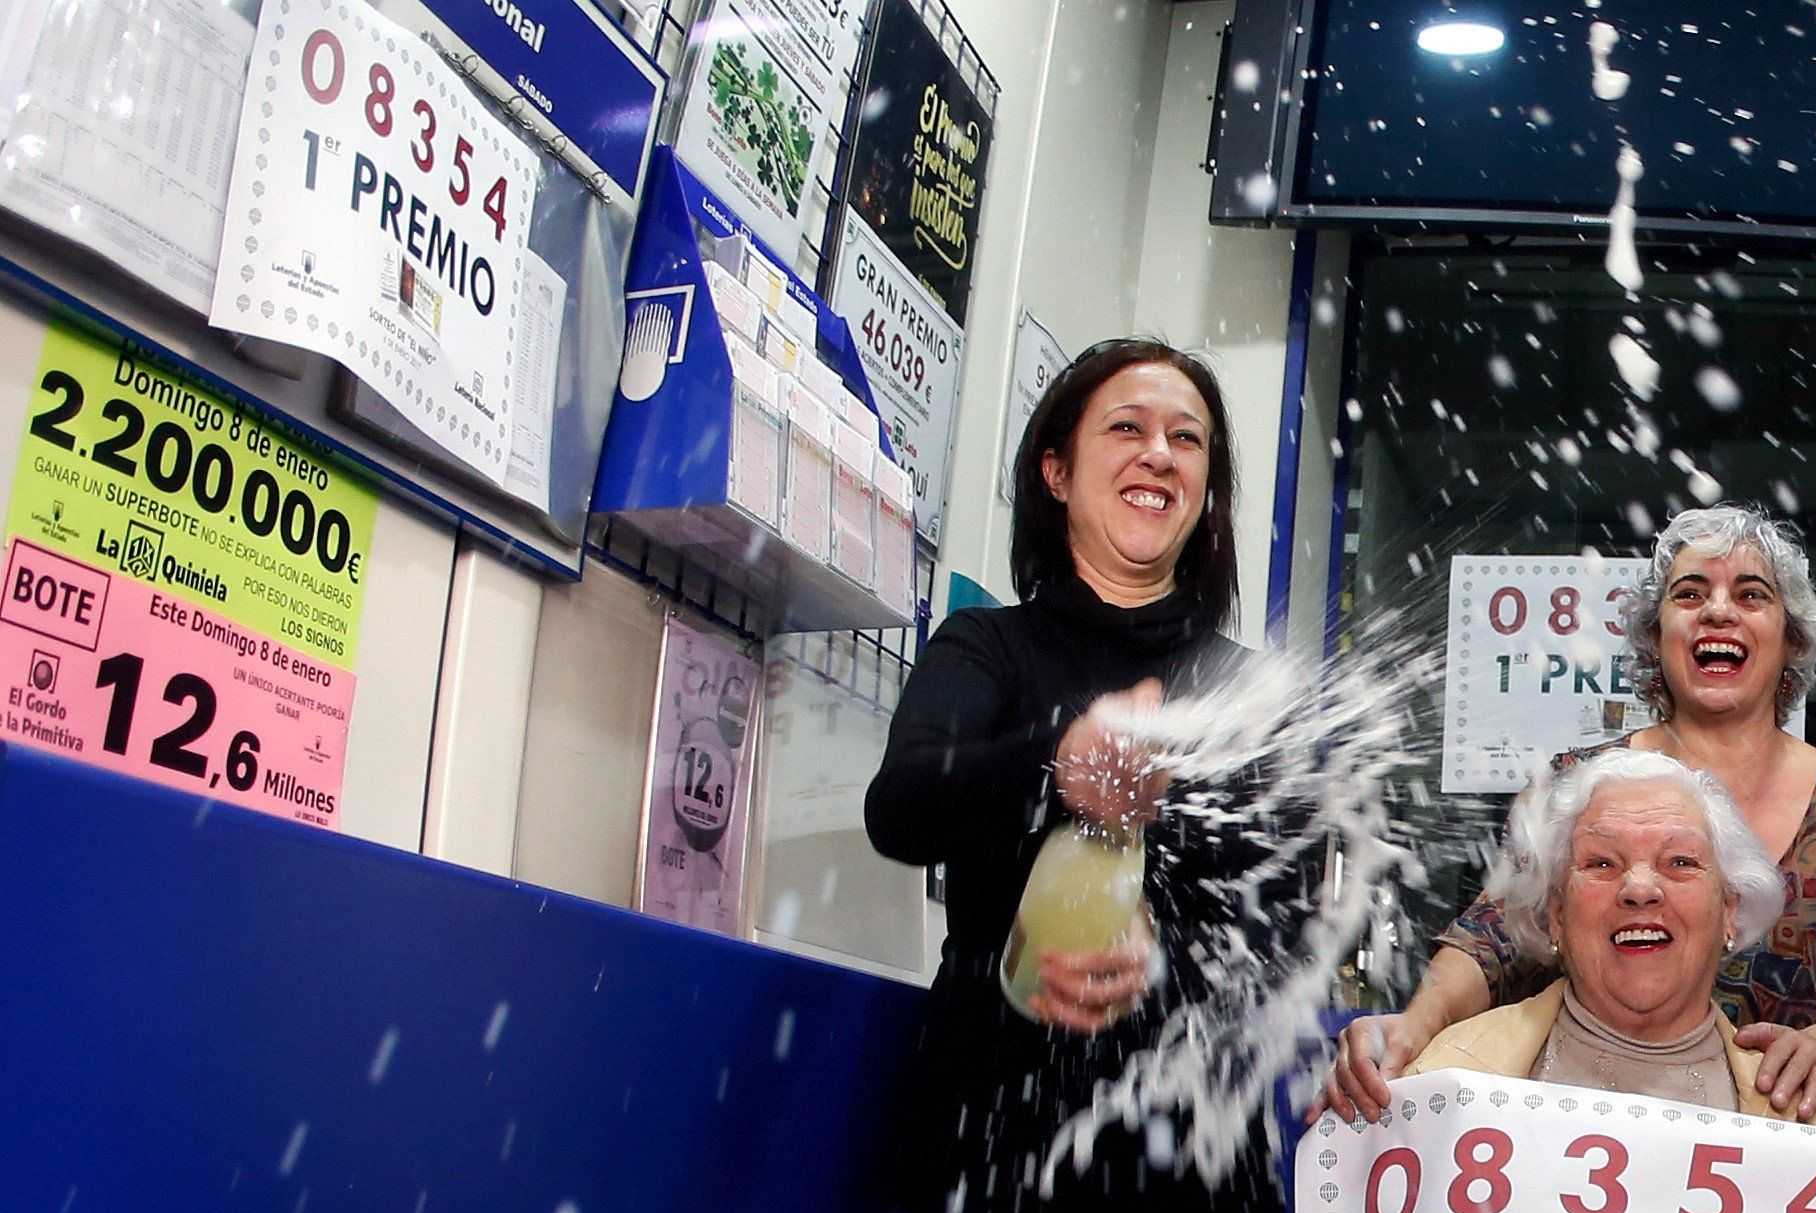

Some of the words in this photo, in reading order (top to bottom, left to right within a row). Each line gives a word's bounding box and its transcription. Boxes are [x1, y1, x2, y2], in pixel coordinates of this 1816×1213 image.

[484, 0, 546, 53] onal
[517, 74, 553, 113] SÁBADO
[350, 151, 495, 317] PREMIO
[856, 253, 899, 314] GRAN
[901, 297, 948, 365] PREMIO
[862, 308, 926, 392] 46.039
[925, 385, 932, 404] €
[114, 354, 224, 432] Domingo
[230, 412, 242, 442] 8
[247, 422, 271, 458] de
[277, 445, 329, 491] enero
[34, 456, 81, 488] GANAR
[83, 473, 103, 496] UN
[106, 482, 200, 537] SUPERBOTE
[201, 526, 217, 545] NO
[219, 535, 234, 553] SE
[234, 541, 277, 575] EXPLICA
[278, 563, 300, 585] CON
[301, 573, 353, 609] PALABRAS
[13, 566, 95, 625] BOTE
[96, 529, 120, 559] La
[162, 555, 228, 602] Quiniela
[243, 576, 266, 600] POR
[266, 585, 288, 608] ESO
[288, 593, 311, 618] NOS
[311, 602, 348, 634] DIERON
[150, 594, 188, 627] Este
[191, 611, 257, 657] Domingo
[260, 640, 269, 661] 8
[272, 646, 289, 670] de
[292, 659, 331, 688] enero
[280, 617, 303, 639] LOS
[306, 627, 345, 656] SIGNOS
[8, 687, 22, 706] El
[26, 693, 66, 721] Gordo
[233, 666, 247, 682] UN
[274, 682, 315, 710] ACERTANTE
[316, 696, 345, 721] PODRÍA
[275, 703, 301, 721] GANAR
[6, 712, 19, 732] la
[22, 716, 84, 753] Primitiva
[96, 652, 261, 792] 12,6
[263, 769, 336, 814] Millones
[683, 747, 725, 810] 12,6
